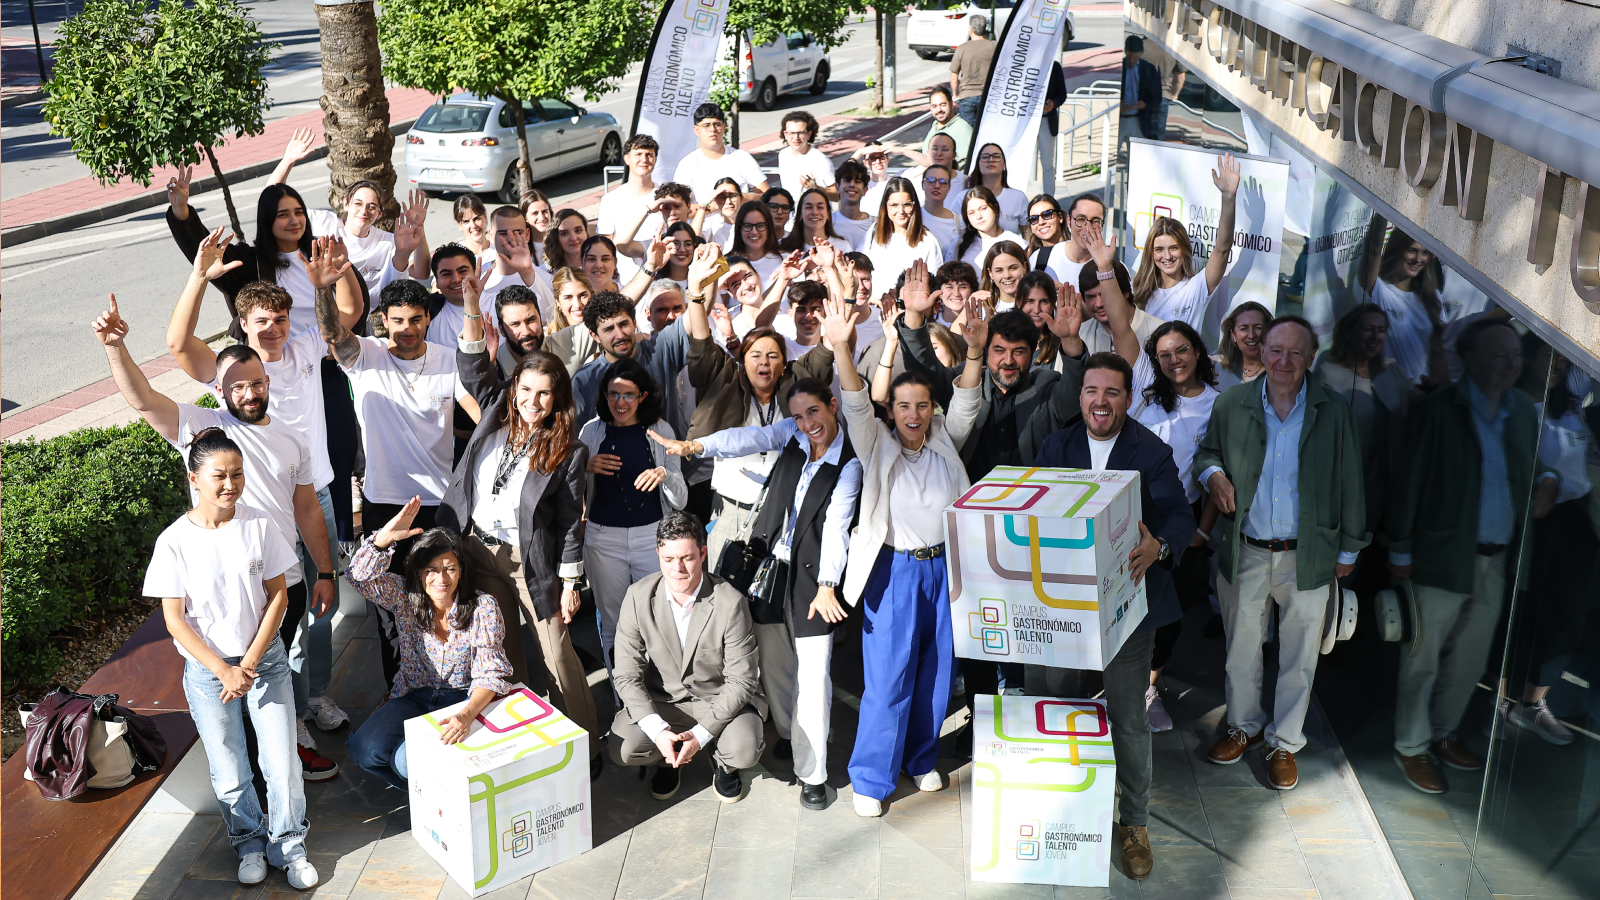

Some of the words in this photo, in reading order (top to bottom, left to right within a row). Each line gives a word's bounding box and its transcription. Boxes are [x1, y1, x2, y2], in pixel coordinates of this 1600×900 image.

[658, 25, 688, 116] GASTRONÓMICO
[1001, 25, 1033, 117] GASTRONÓMICO
[643, 65, 664, 114] CAMPUS
[674, 67, 696, 118] TALENTO
[1189, 204, 1222, 224] CAMP
[1011, 603, 1048, 618] CAMPUS
[1012, 617, 1082, 634] GASTRONÓMICO
[1014, 629, 1053, 644] TALENTO
[1015, 642, 1042, 655] JOVEN
[535, 802, 562, 819] CAMPUS
[535, 802, 584, 829] GASTRONÓMICO
[536, 819, 565, 838] TALENTO
[1045, 822, 1076, 833] CAMPUS
[537, 833, 557, 846] JOVEN
[1044, 830, 1103, 843] GASTRONÓMICO
[1044, 840, 1077, 851] TALENTO
[1044, 850, 1067, 860] JOVEN
